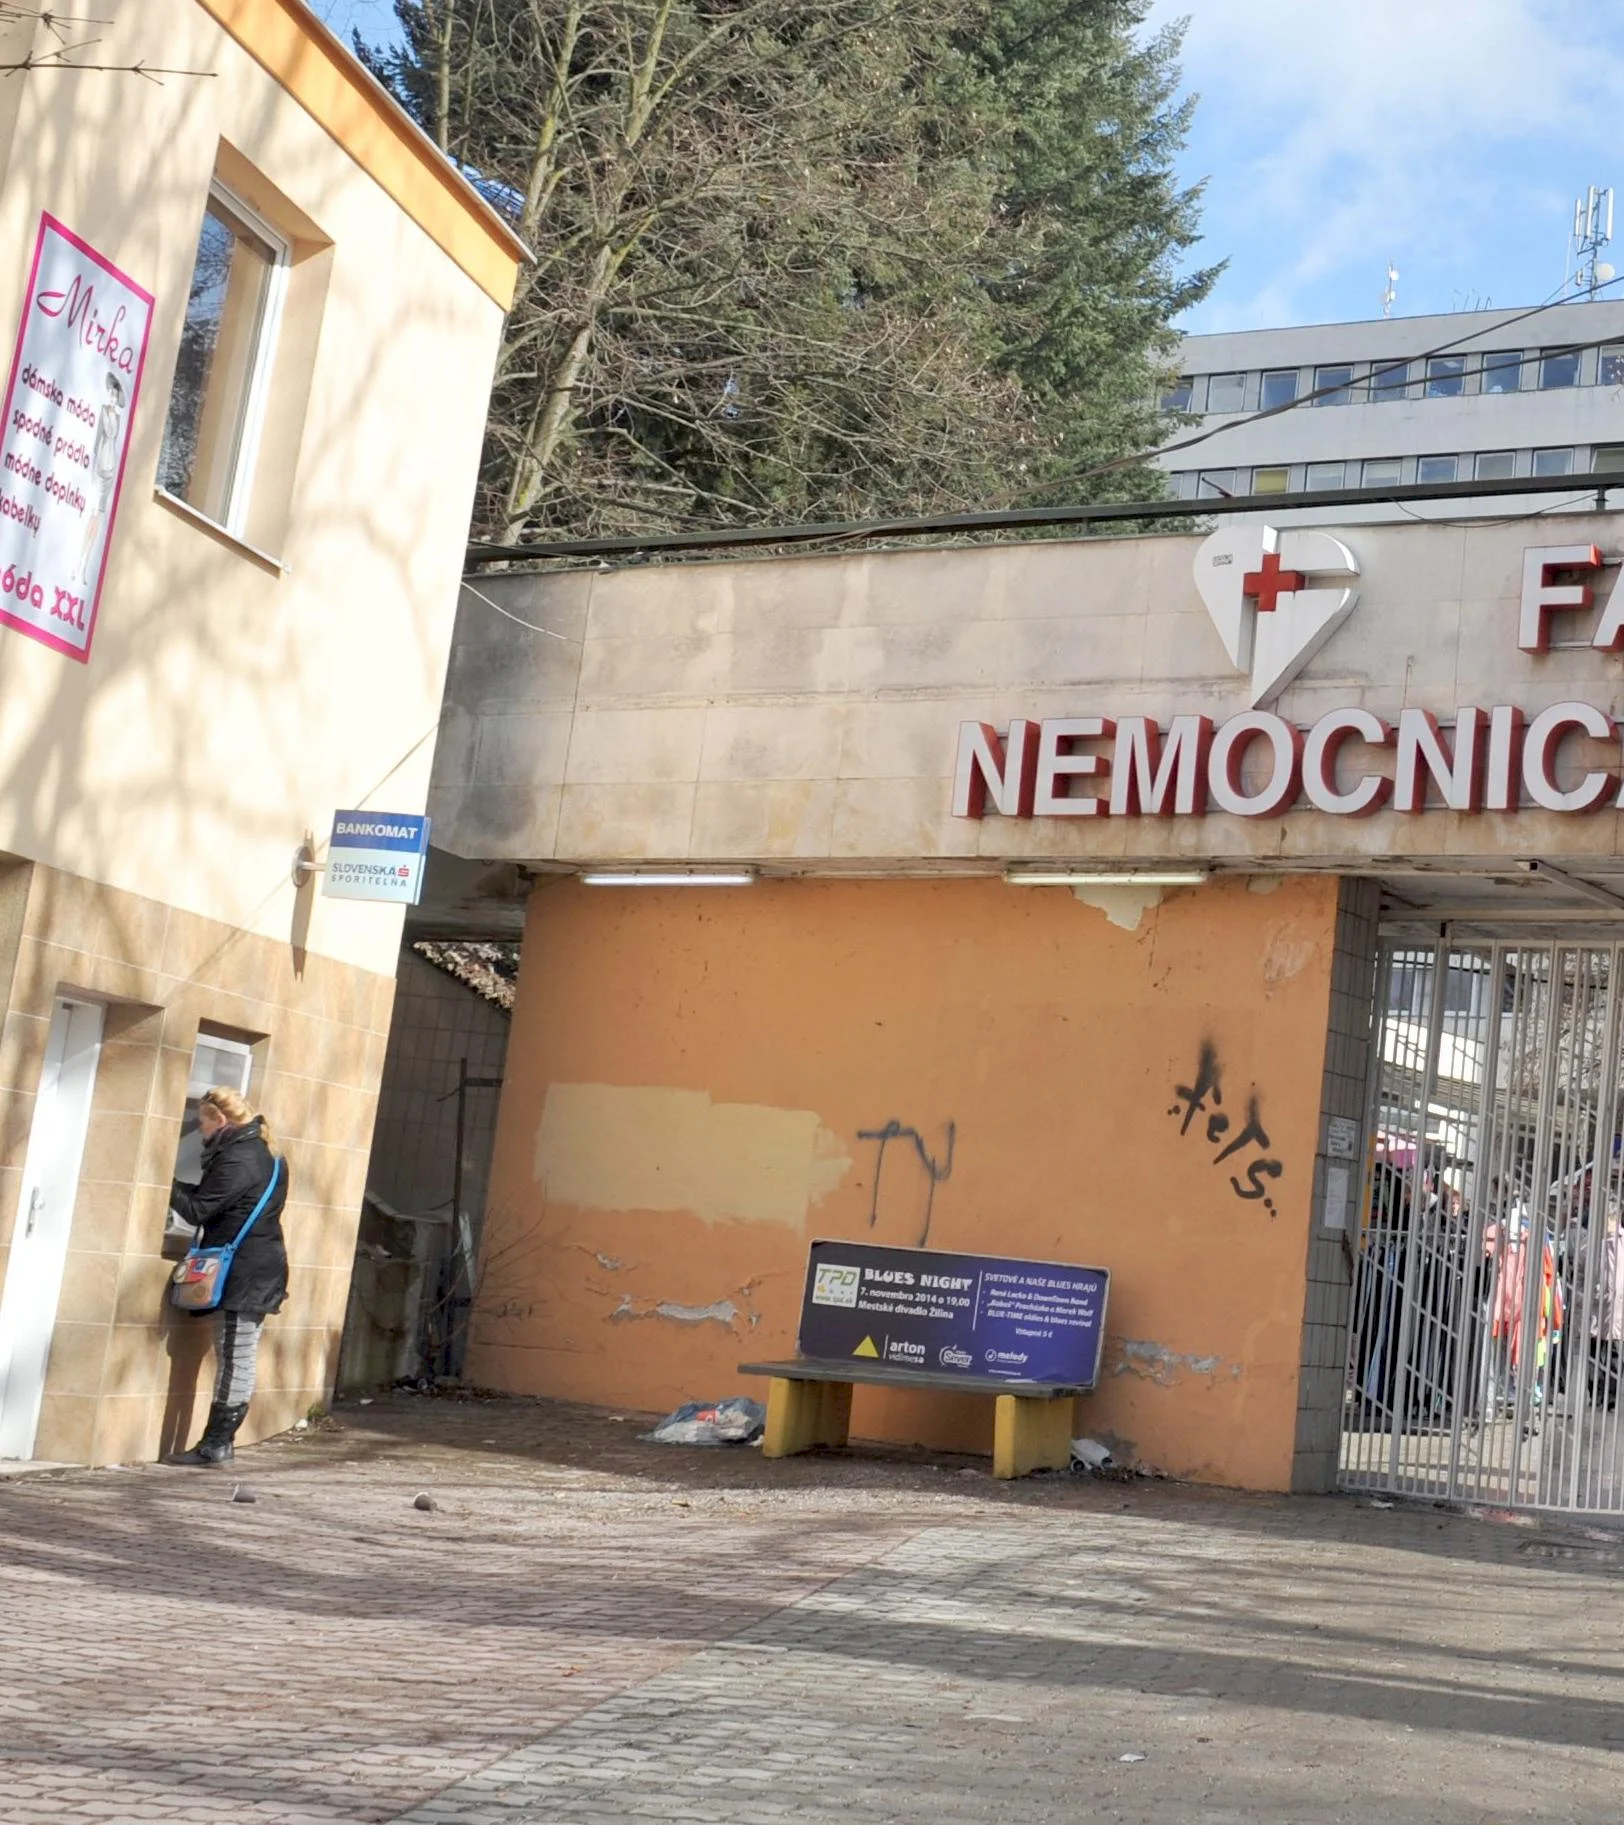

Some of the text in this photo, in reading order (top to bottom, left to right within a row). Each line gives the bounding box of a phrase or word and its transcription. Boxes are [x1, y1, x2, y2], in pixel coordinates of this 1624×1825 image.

[36, 274, 134, 374] Mirka
[21, 363, 96, 429] dámska móda
[12, 408, 90, 469] spodné prádlo
[4, 452, 87, 518] módne doplnky
[0, 563, 85, 632] óda XXL
[336, 822, 418, 840] BANKOMAT
[863, 1268, 973, 1292] BLUES NIGHT
[984, 1272, 1018, 1284] SVETOVÉ
[1018, 1276, 1025, 1284] A
[1025, 1276, 1047, 1288] NAŠE
[1047, 1279, 1071, 1290] BLUES
[860, 1287, 869, 1297] 7.
[869, 1289, 914, 1302] novembra
[915, 1293, 937, 1304] 2014
[857, 1300, 954, 1320] Mestské divadlo Žilina
[890, 1341, 926, 1355] arton
[998, 1351, 1028, 1364] melody
